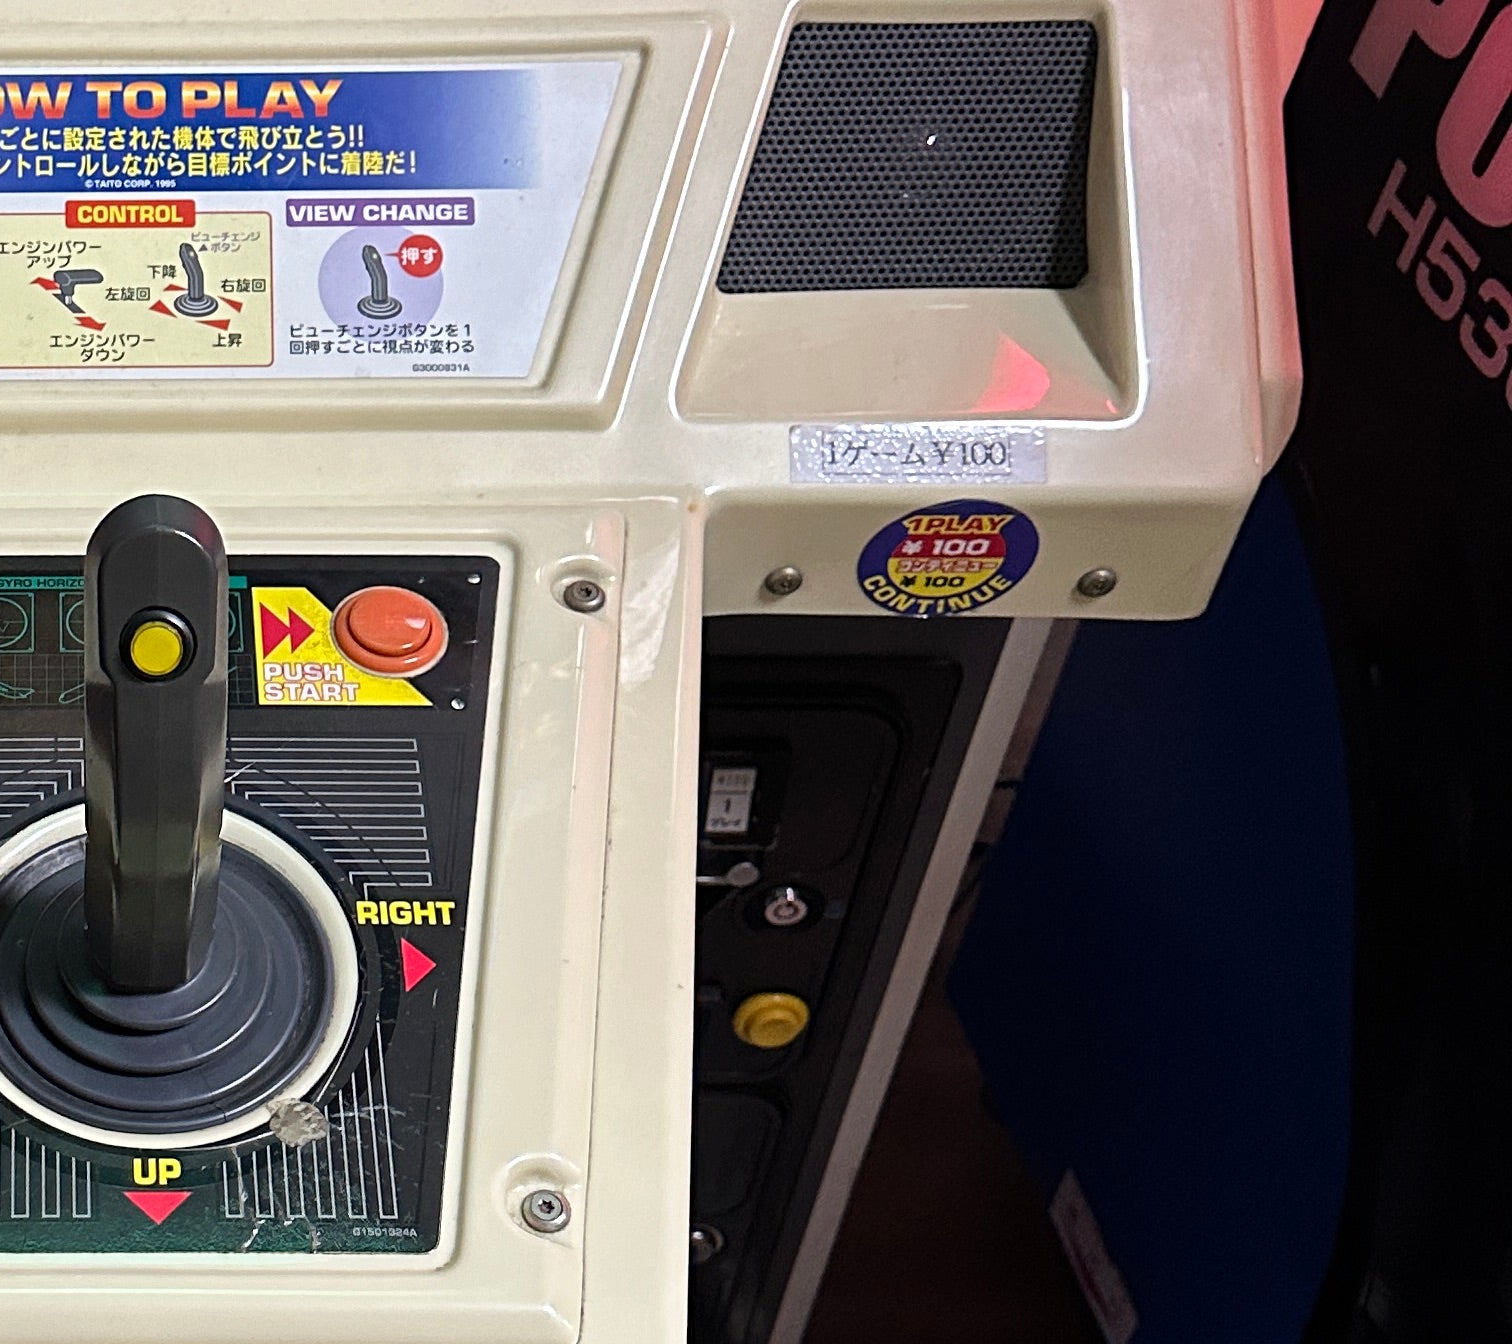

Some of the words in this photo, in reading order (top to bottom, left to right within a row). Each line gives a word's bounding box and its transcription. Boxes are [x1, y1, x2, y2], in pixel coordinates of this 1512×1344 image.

[85, 81, 167, 119] TO
[181, 79, 344, 119] PLAY
[123, 178, 153, 188] CORP.
[76, 204, 184, 224] CONTROL
[289, 204, 357, 223] VIEW
[362, 203, 469, 222] CHANGE
[191, 231, 261, 243] ビューチェンジ
[210, 242, 241, 253] ボタン
[26, 256, 72, 269] アップ
[400, 246, 438, 266] 押す
[147, 264, 177, 279] 下降
[221, 278, 266, 293] 右旋回
[1367, 158, 1512, 413] H53
[105, 287, 151, 302] 左旋回
[49, 333, 155, 348] エンジンパワー
[212, 333, 243, 348] 上昇
[289, 339, 475, 355] 回押すごとに視点が変わる
[80, 348, 126, 362] ダウン
[862, 574, 1013, 614] CONTINUE
[263, 662, 344, 683] PUSH
[264, 683, 360, 703] START
[356, 900, 455, 927] RIGHT
[132, 1158, 182, 1186] UP
